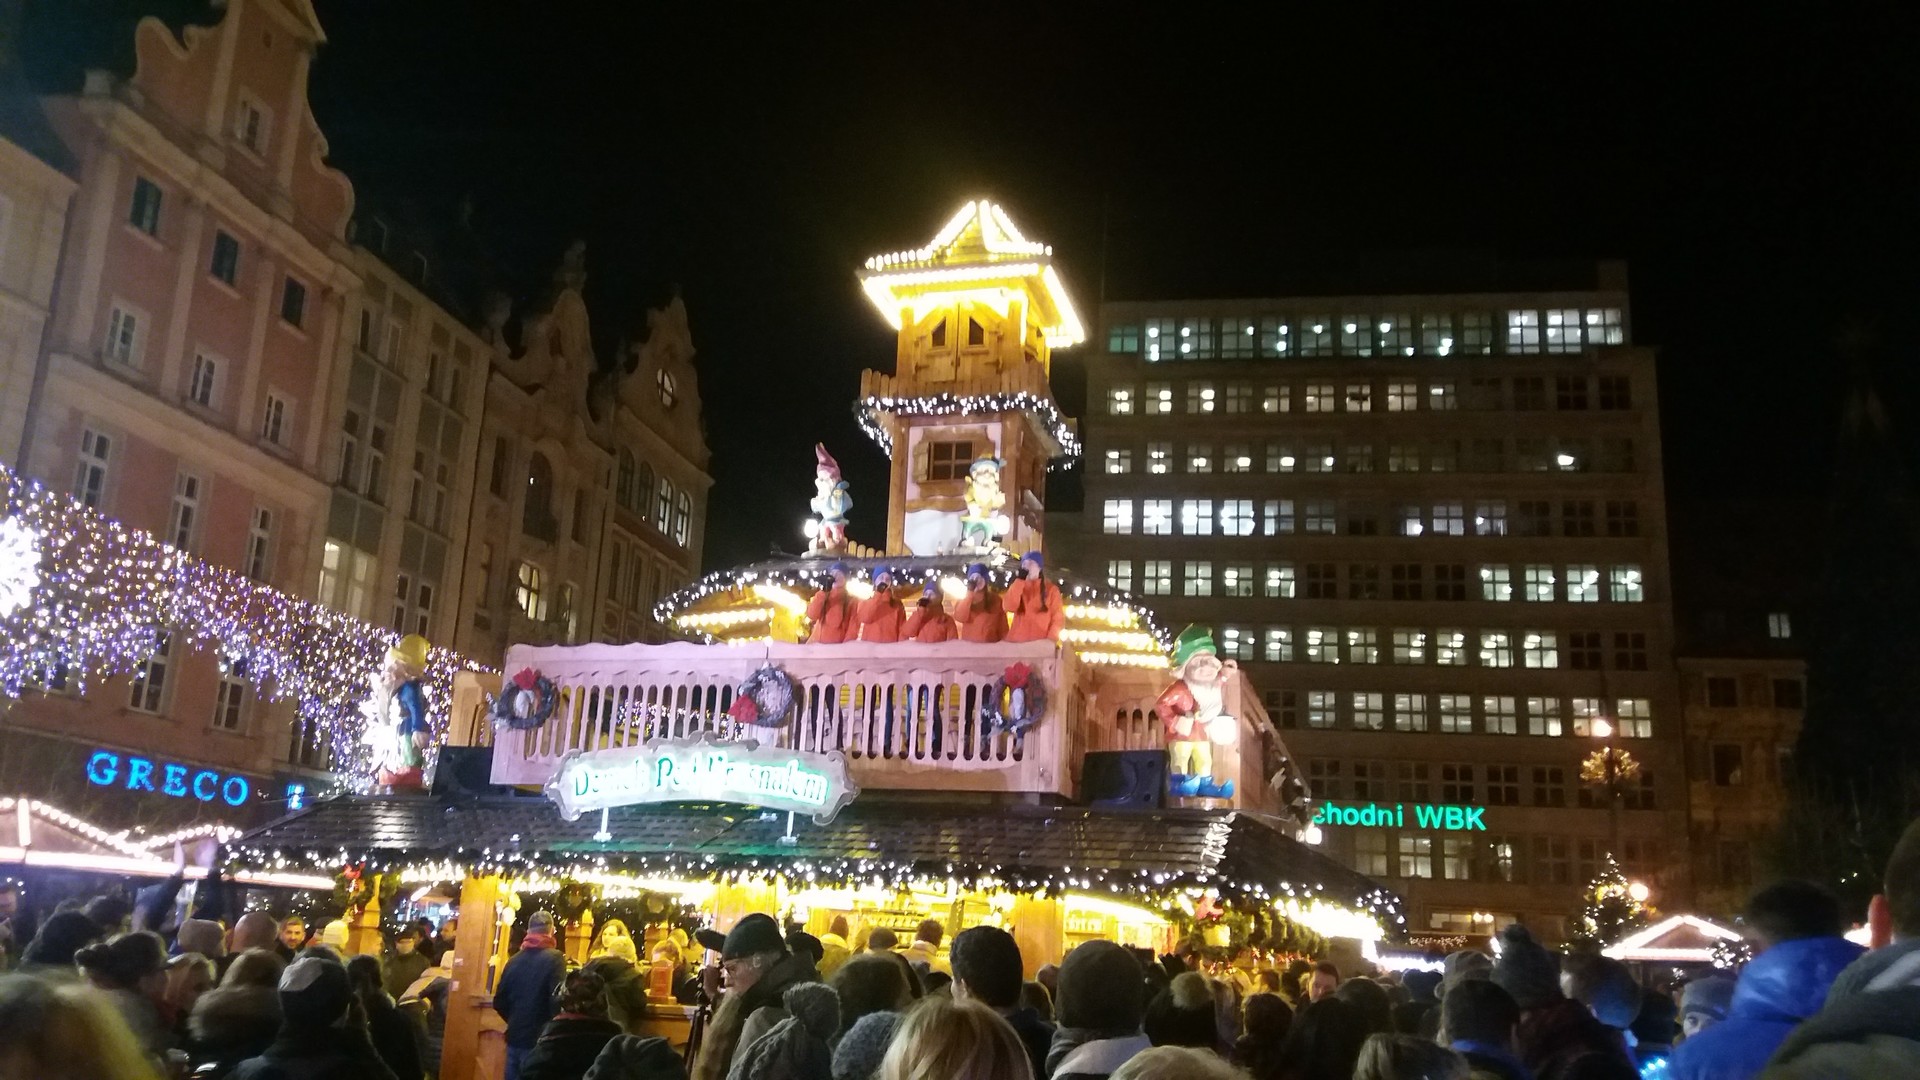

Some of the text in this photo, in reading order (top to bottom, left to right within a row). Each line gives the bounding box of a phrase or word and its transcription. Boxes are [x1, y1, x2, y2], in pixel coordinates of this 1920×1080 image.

[86, 750, 250, 807] GRECO
[573, 757, 648, 798] Domk
[706, 754, 829, 802] Krsnalem
[1415, 804, 1487, 831] WBK
